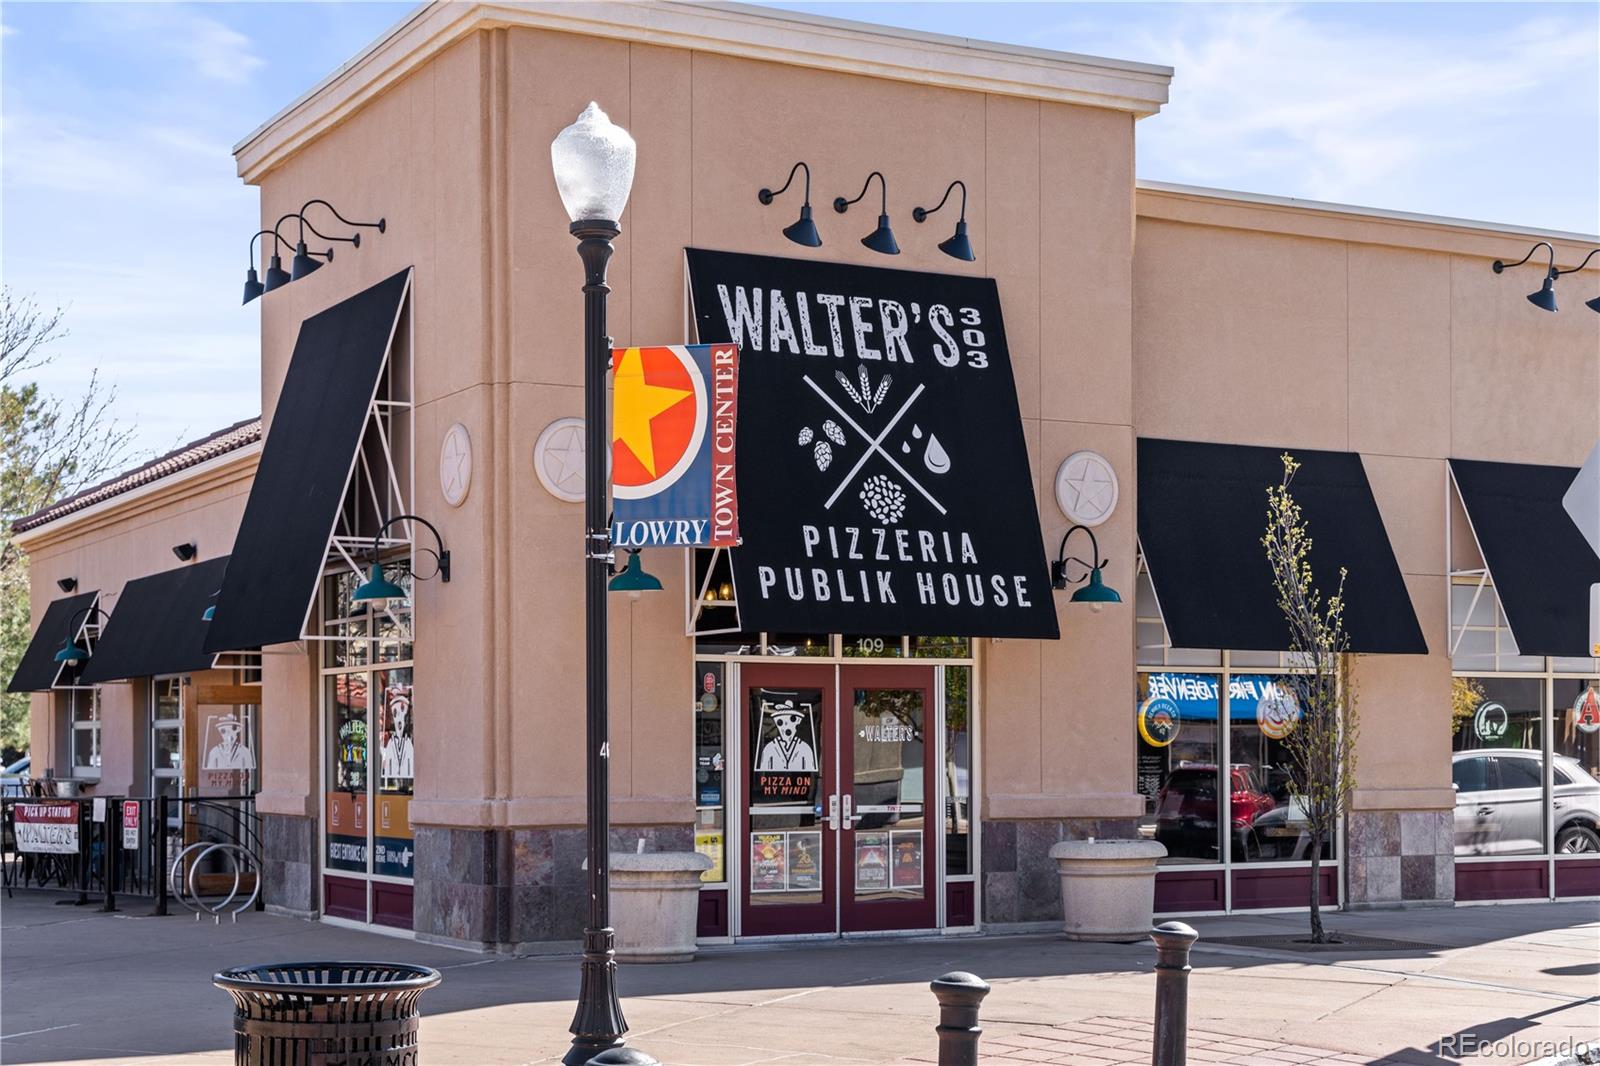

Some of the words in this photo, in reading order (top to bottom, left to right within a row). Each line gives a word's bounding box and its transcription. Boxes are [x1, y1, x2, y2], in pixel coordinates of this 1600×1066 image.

[717, 284, 961, 368] WALTER'S
[959, 307, 989, 369] 303
[715, 348, 734, 454] CENTER
[714, 463, 734, 541] TOWN
[614, 519, 709, 546] LOWRY
[802, 525, 978, 564] PIZZERIA
[758, 566, 897, 604] PUBLIK
[916, 572, 1032, 607] HOUSE
[856, 637, 884, 653] 109
[864, 724, 914, 742] WALTER'S
[760, 776, 792, 786] PIZZA
[796, 776, 811, 786] ON
[764, 786, 778, 795] MY
[780, 786, 808, 795] MIND
[125, 816, 138, 826] ONLY
[126, 805, 138, 816] EXIT
